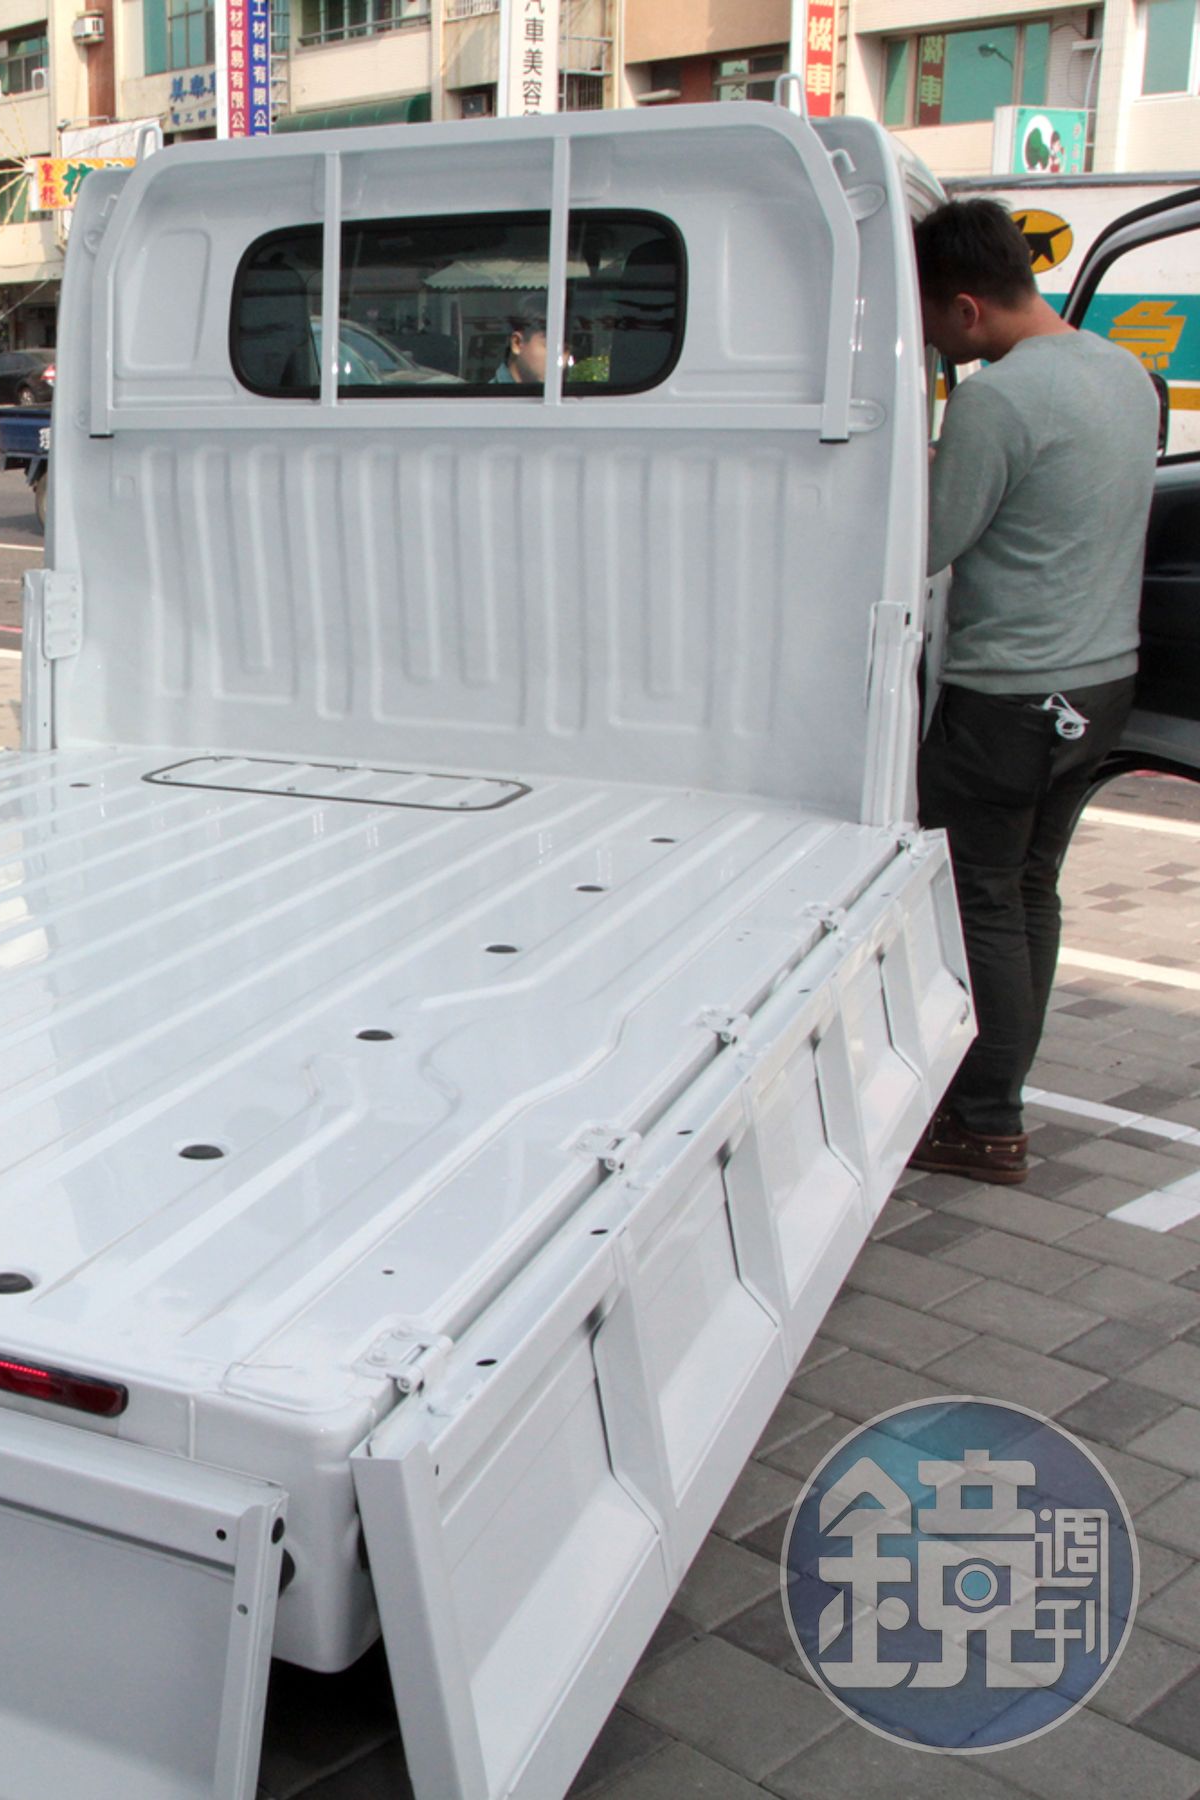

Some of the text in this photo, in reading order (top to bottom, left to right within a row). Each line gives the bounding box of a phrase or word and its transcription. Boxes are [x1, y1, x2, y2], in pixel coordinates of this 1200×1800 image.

[230, 0, 246, 136] 材貿易有限公
[523, 0, 544, 116] 車美容
[806, 0, 833, 96] 機車
